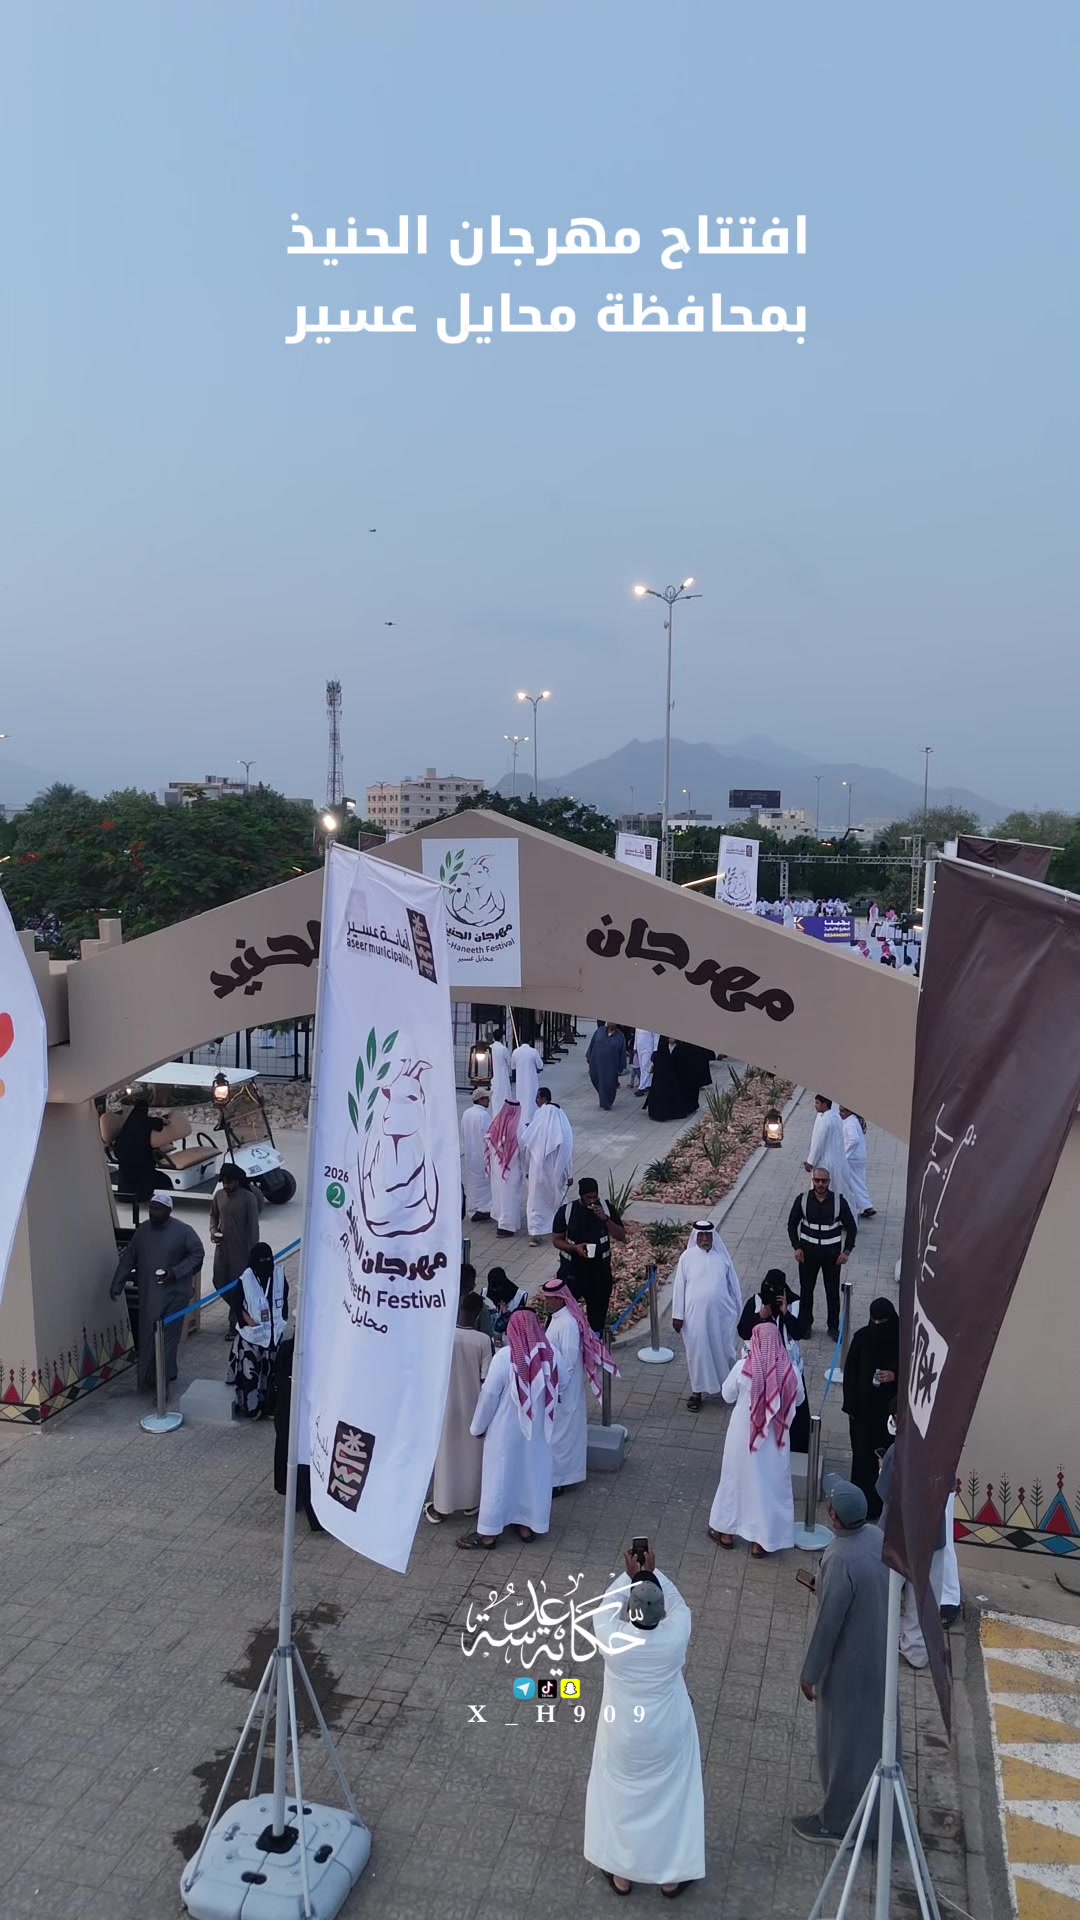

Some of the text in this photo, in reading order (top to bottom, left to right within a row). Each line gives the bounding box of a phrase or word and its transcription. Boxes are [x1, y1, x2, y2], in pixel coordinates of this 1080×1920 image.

[346, 921, 380, 939] عسير
[474, 923, 513, 943] مهرجان
[346, 937, 414, 970] aseer municipality
[485, 937, 516, 954] Festival
[586, 913, 795, 1022] مهرجان
[323, 1165, 350, 1184] 2026
[330, 1184, 342, 1206] 2
[361, 1250, 448, 1283] مهرجان
[376, 1288, 447, 1310] Festival
